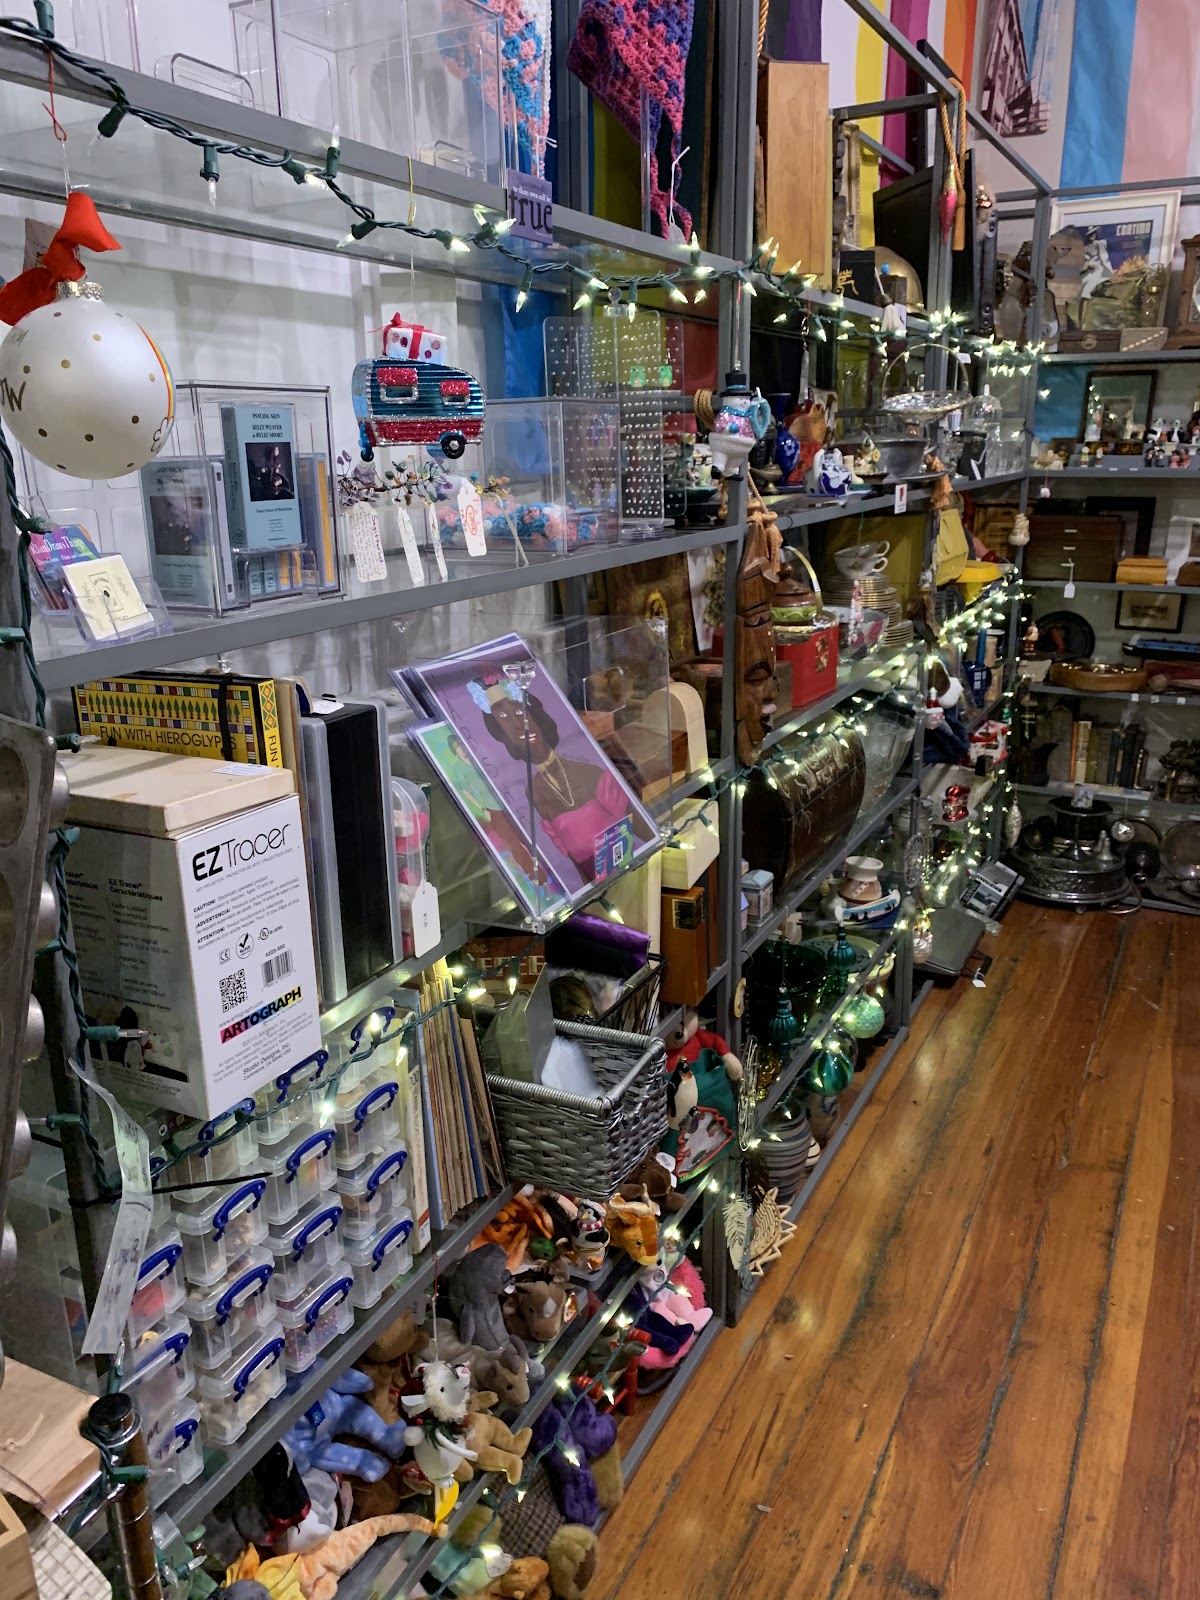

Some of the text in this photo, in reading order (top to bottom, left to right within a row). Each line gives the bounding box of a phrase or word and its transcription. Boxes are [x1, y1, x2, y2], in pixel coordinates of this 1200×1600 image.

[508, 189, 552, 233] true
[100, 726, 122, 740] FUN
[124, 728, 152, 742] WITH
[156, 731, 237, 750] HIEROGLYPS
[268, 735, 279, 762] FUN
[222, 986, 302, 1043] ARTOGRAPH
